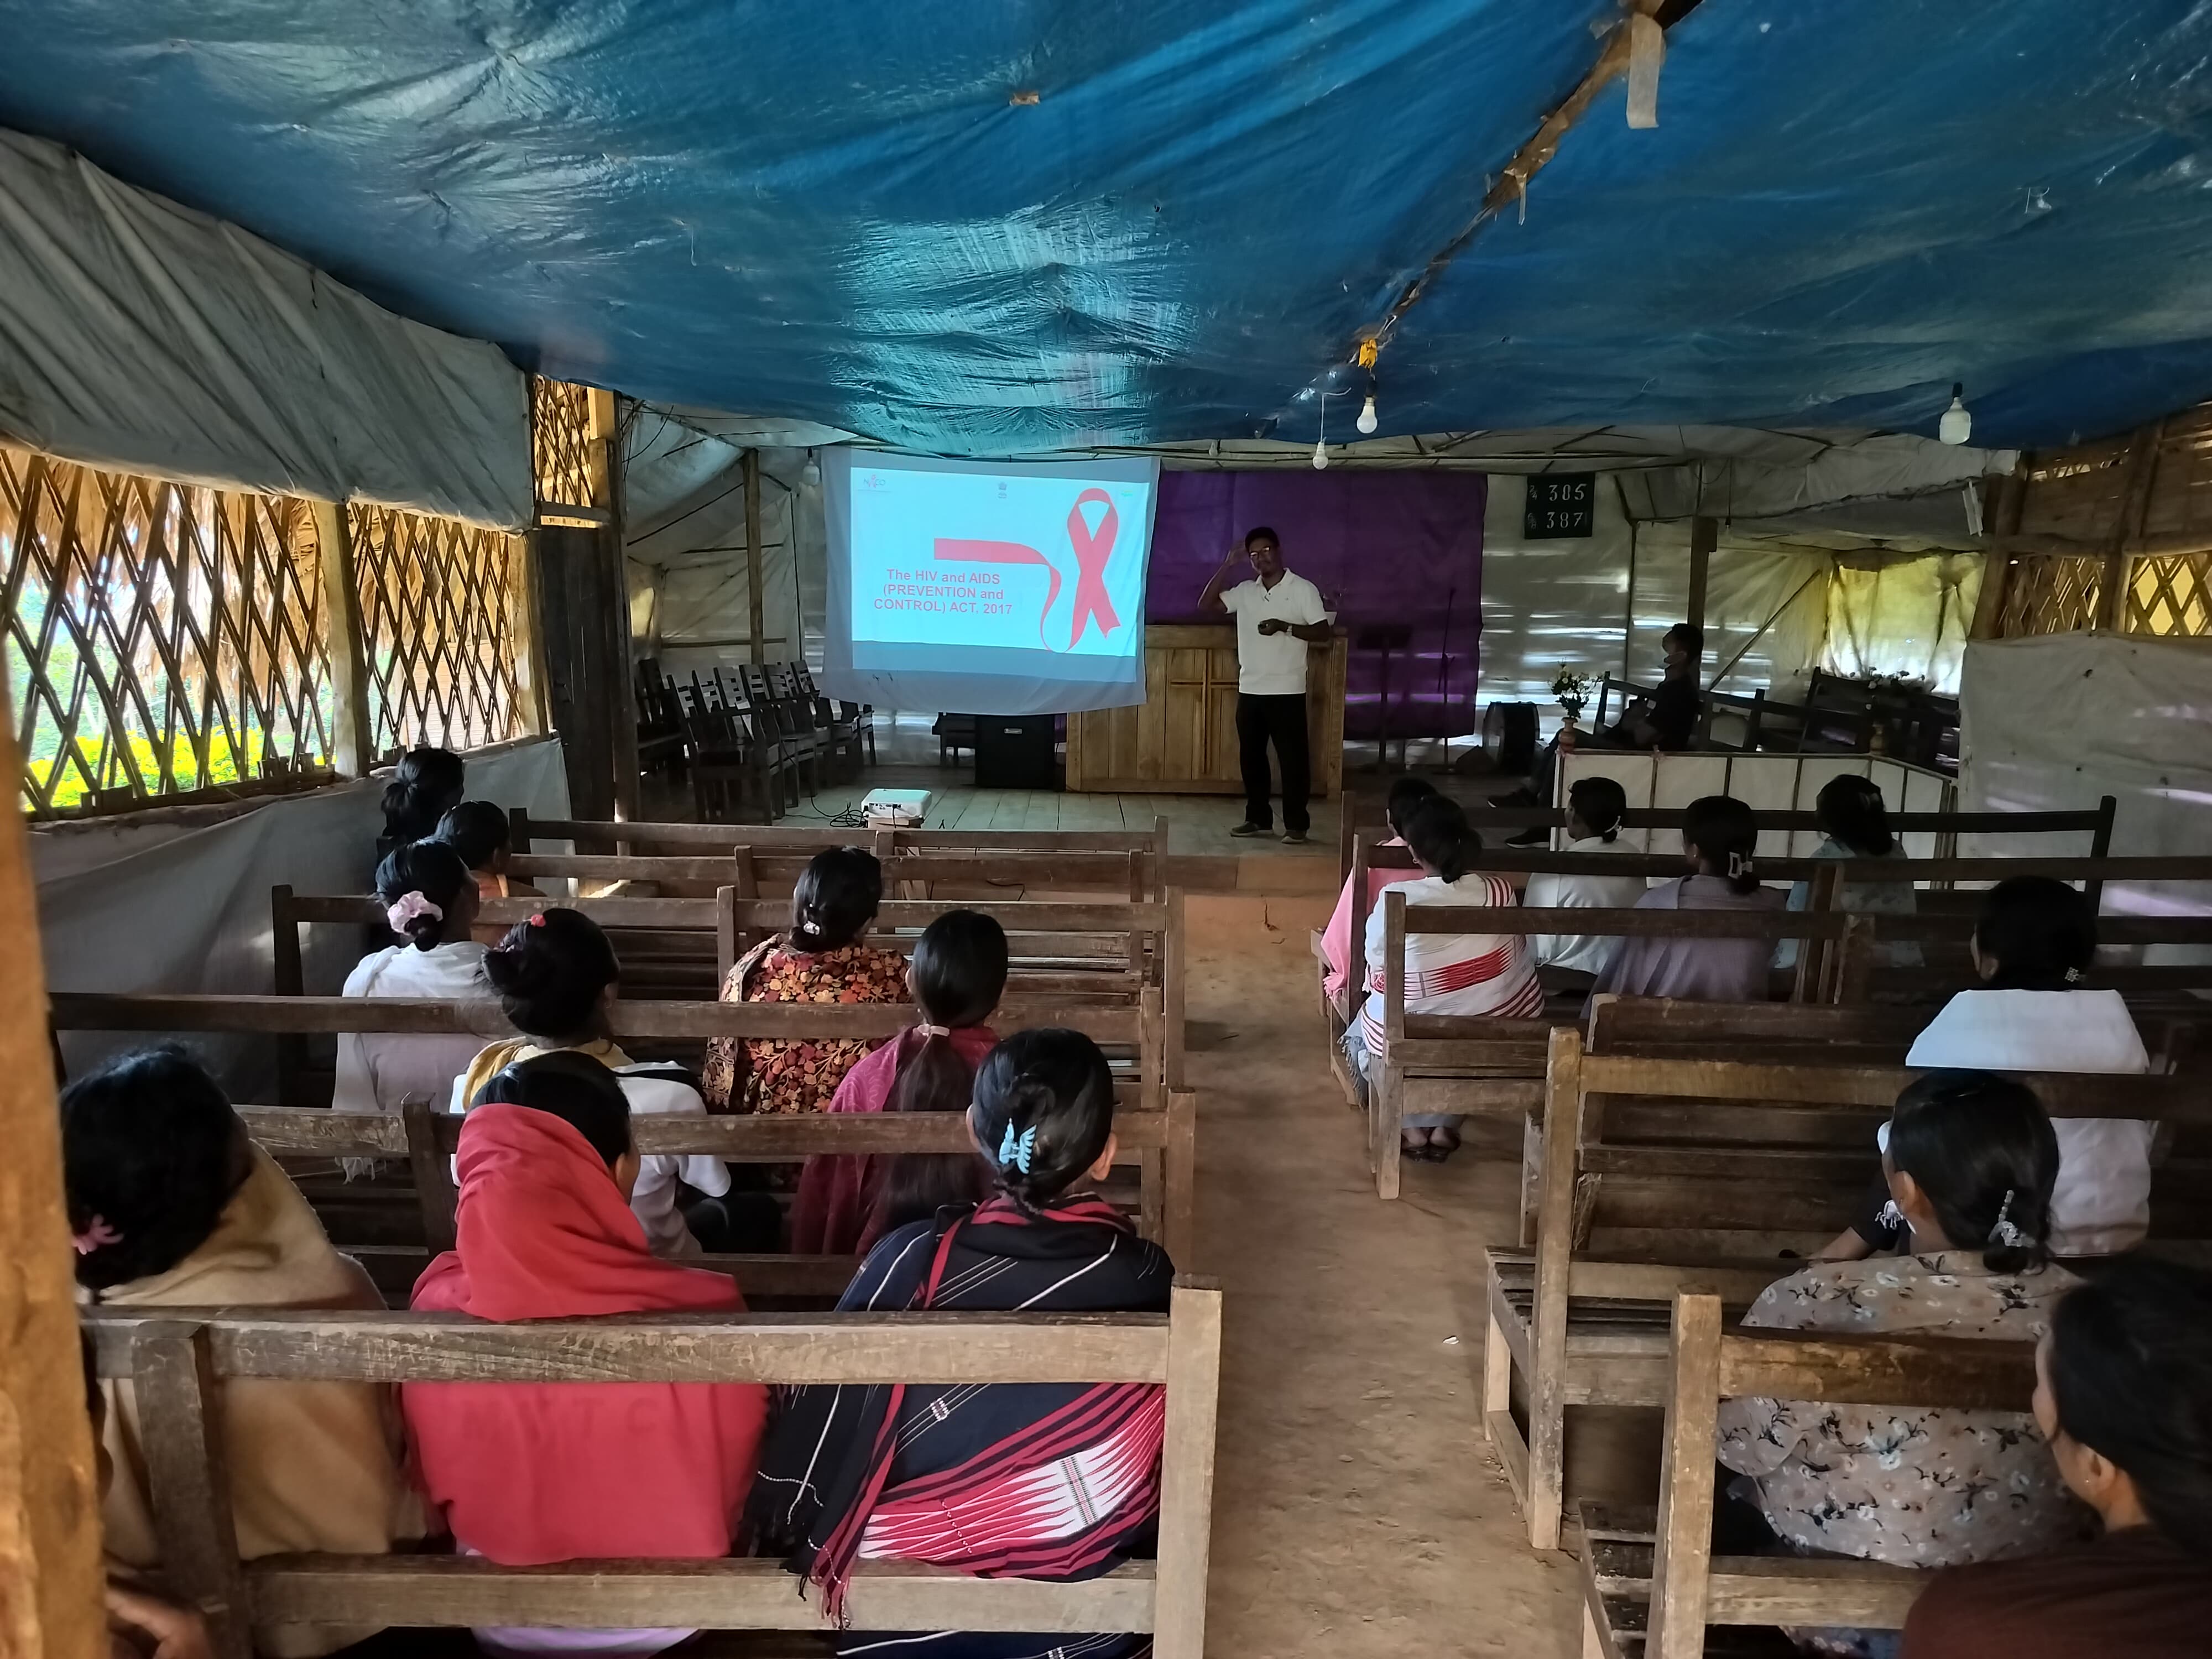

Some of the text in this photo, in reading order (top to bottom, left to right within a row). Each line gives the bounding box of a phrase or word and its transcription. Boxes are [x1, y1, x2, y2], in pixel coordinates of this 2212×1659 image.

[1548, 483, 1587, 501] 305
[1547, 512, 1583, 529] 387
[886, 569, 1000, 584] The HIV and AIDS
[884, 584, 1003, 599] (PREVENTION and
[874, 598, 946, 614] CONTROL)
[983, 603, 1013, 614] 2017
